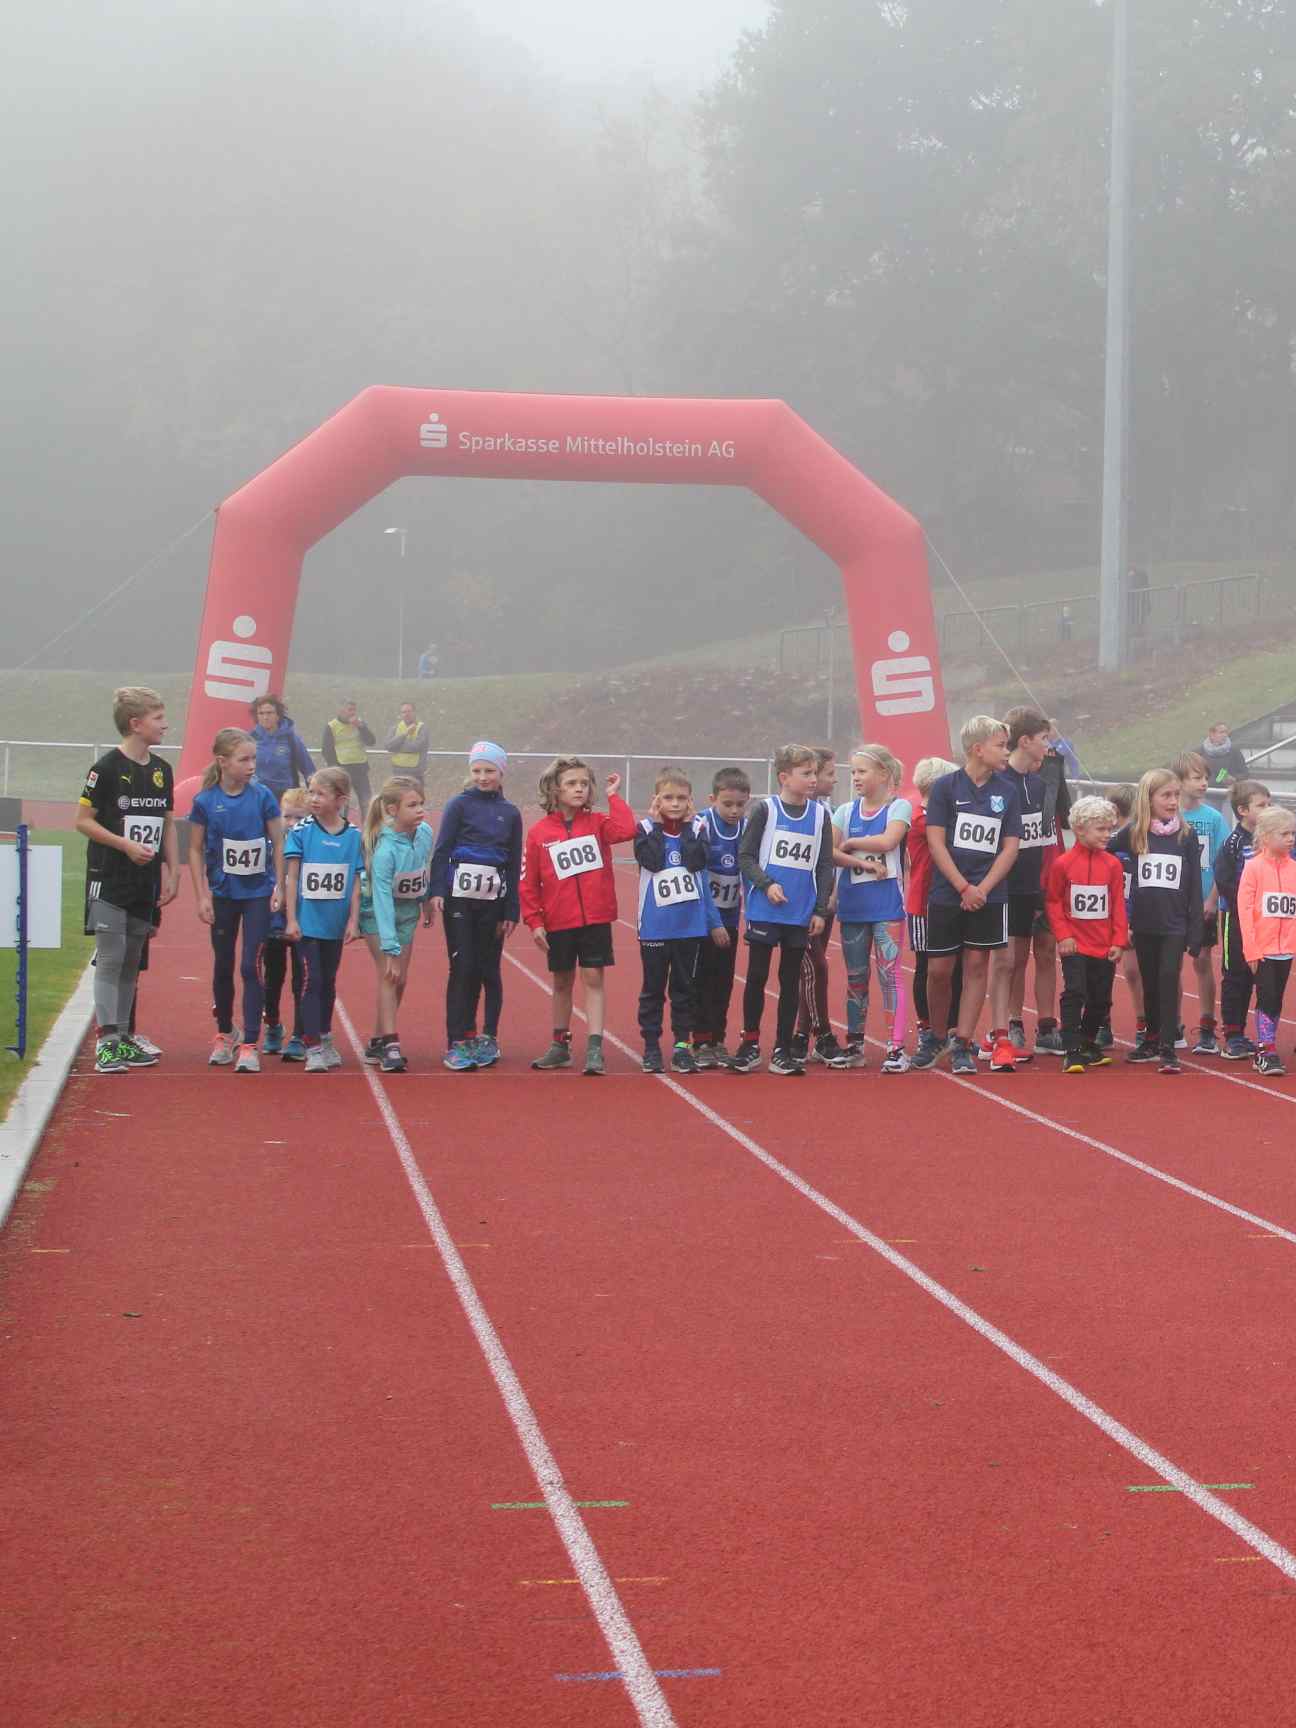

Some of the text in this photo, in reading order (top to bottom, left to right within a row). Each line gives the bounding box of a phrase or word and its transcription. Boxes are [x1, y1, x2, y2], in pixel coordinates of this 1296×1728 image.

[458, 431, 736, 458] Sparkasse Mittelholstein AG
[130, 824, 163, 845] 624
[959, 822, 997, 845] 604
[226, 848, 262, 868] 647
[557, 845, 597, 870] 608
[775, 839, 813, 863] 644
[306, 872, 345, 892] 648
[1141, 862, 1178, 881] 619
[459, 872, 495, 893] 611
[658, 874, 695, 898] 618
[1074, 893, 1106, 912] 621
[1266, 895, 1296, 915] 605
